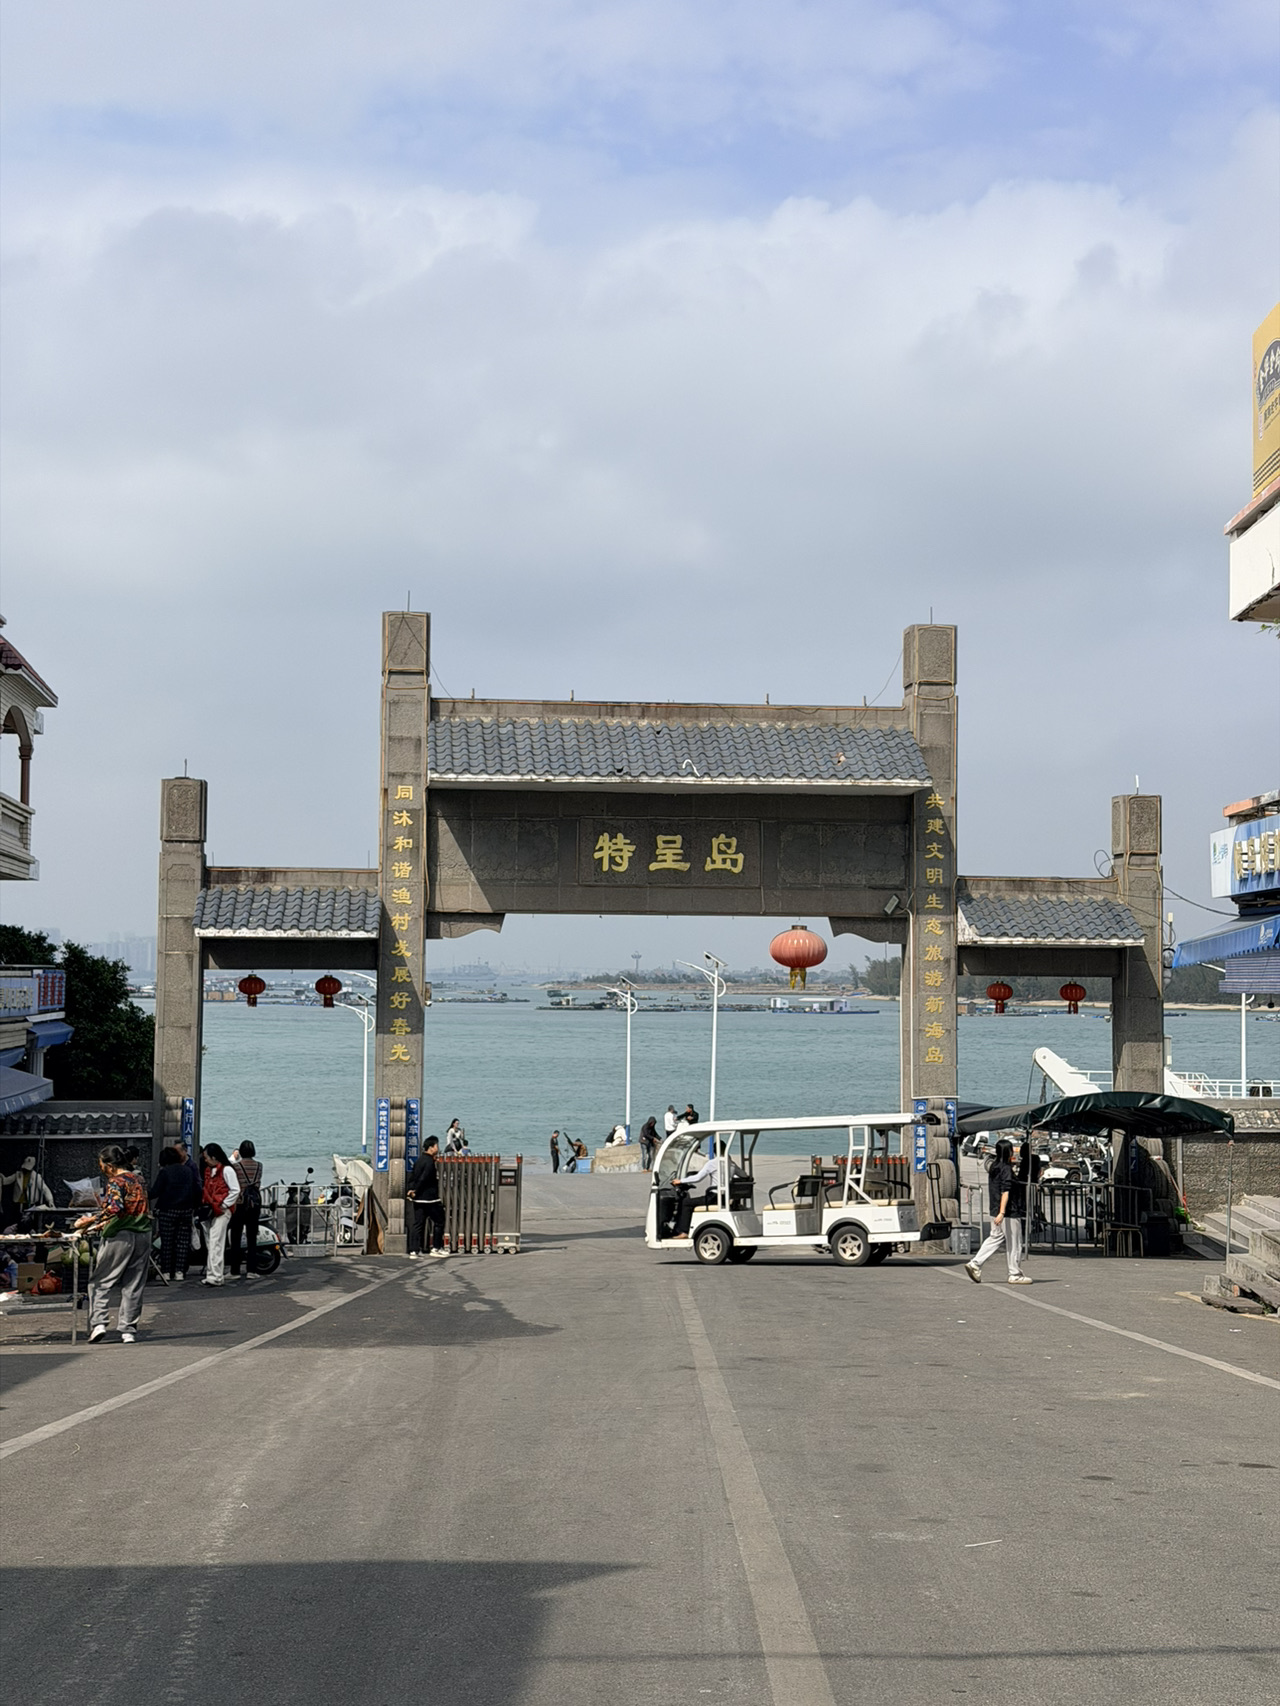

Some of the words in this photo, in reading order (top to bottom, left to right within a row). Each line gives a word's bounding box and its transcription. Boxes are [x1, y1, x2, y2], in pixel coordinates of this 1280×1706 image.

[593, 832, 745, 874] 特呈岛
[389, 785, 413, 1061] 同沐和谐渔村发展好春光
[924, 793, 945, 1064] 共建文明生态旅游新海岛
[408, 1114, 418, 1157] 汽车通道
[916, 1126, 926, 1158] 车通道
